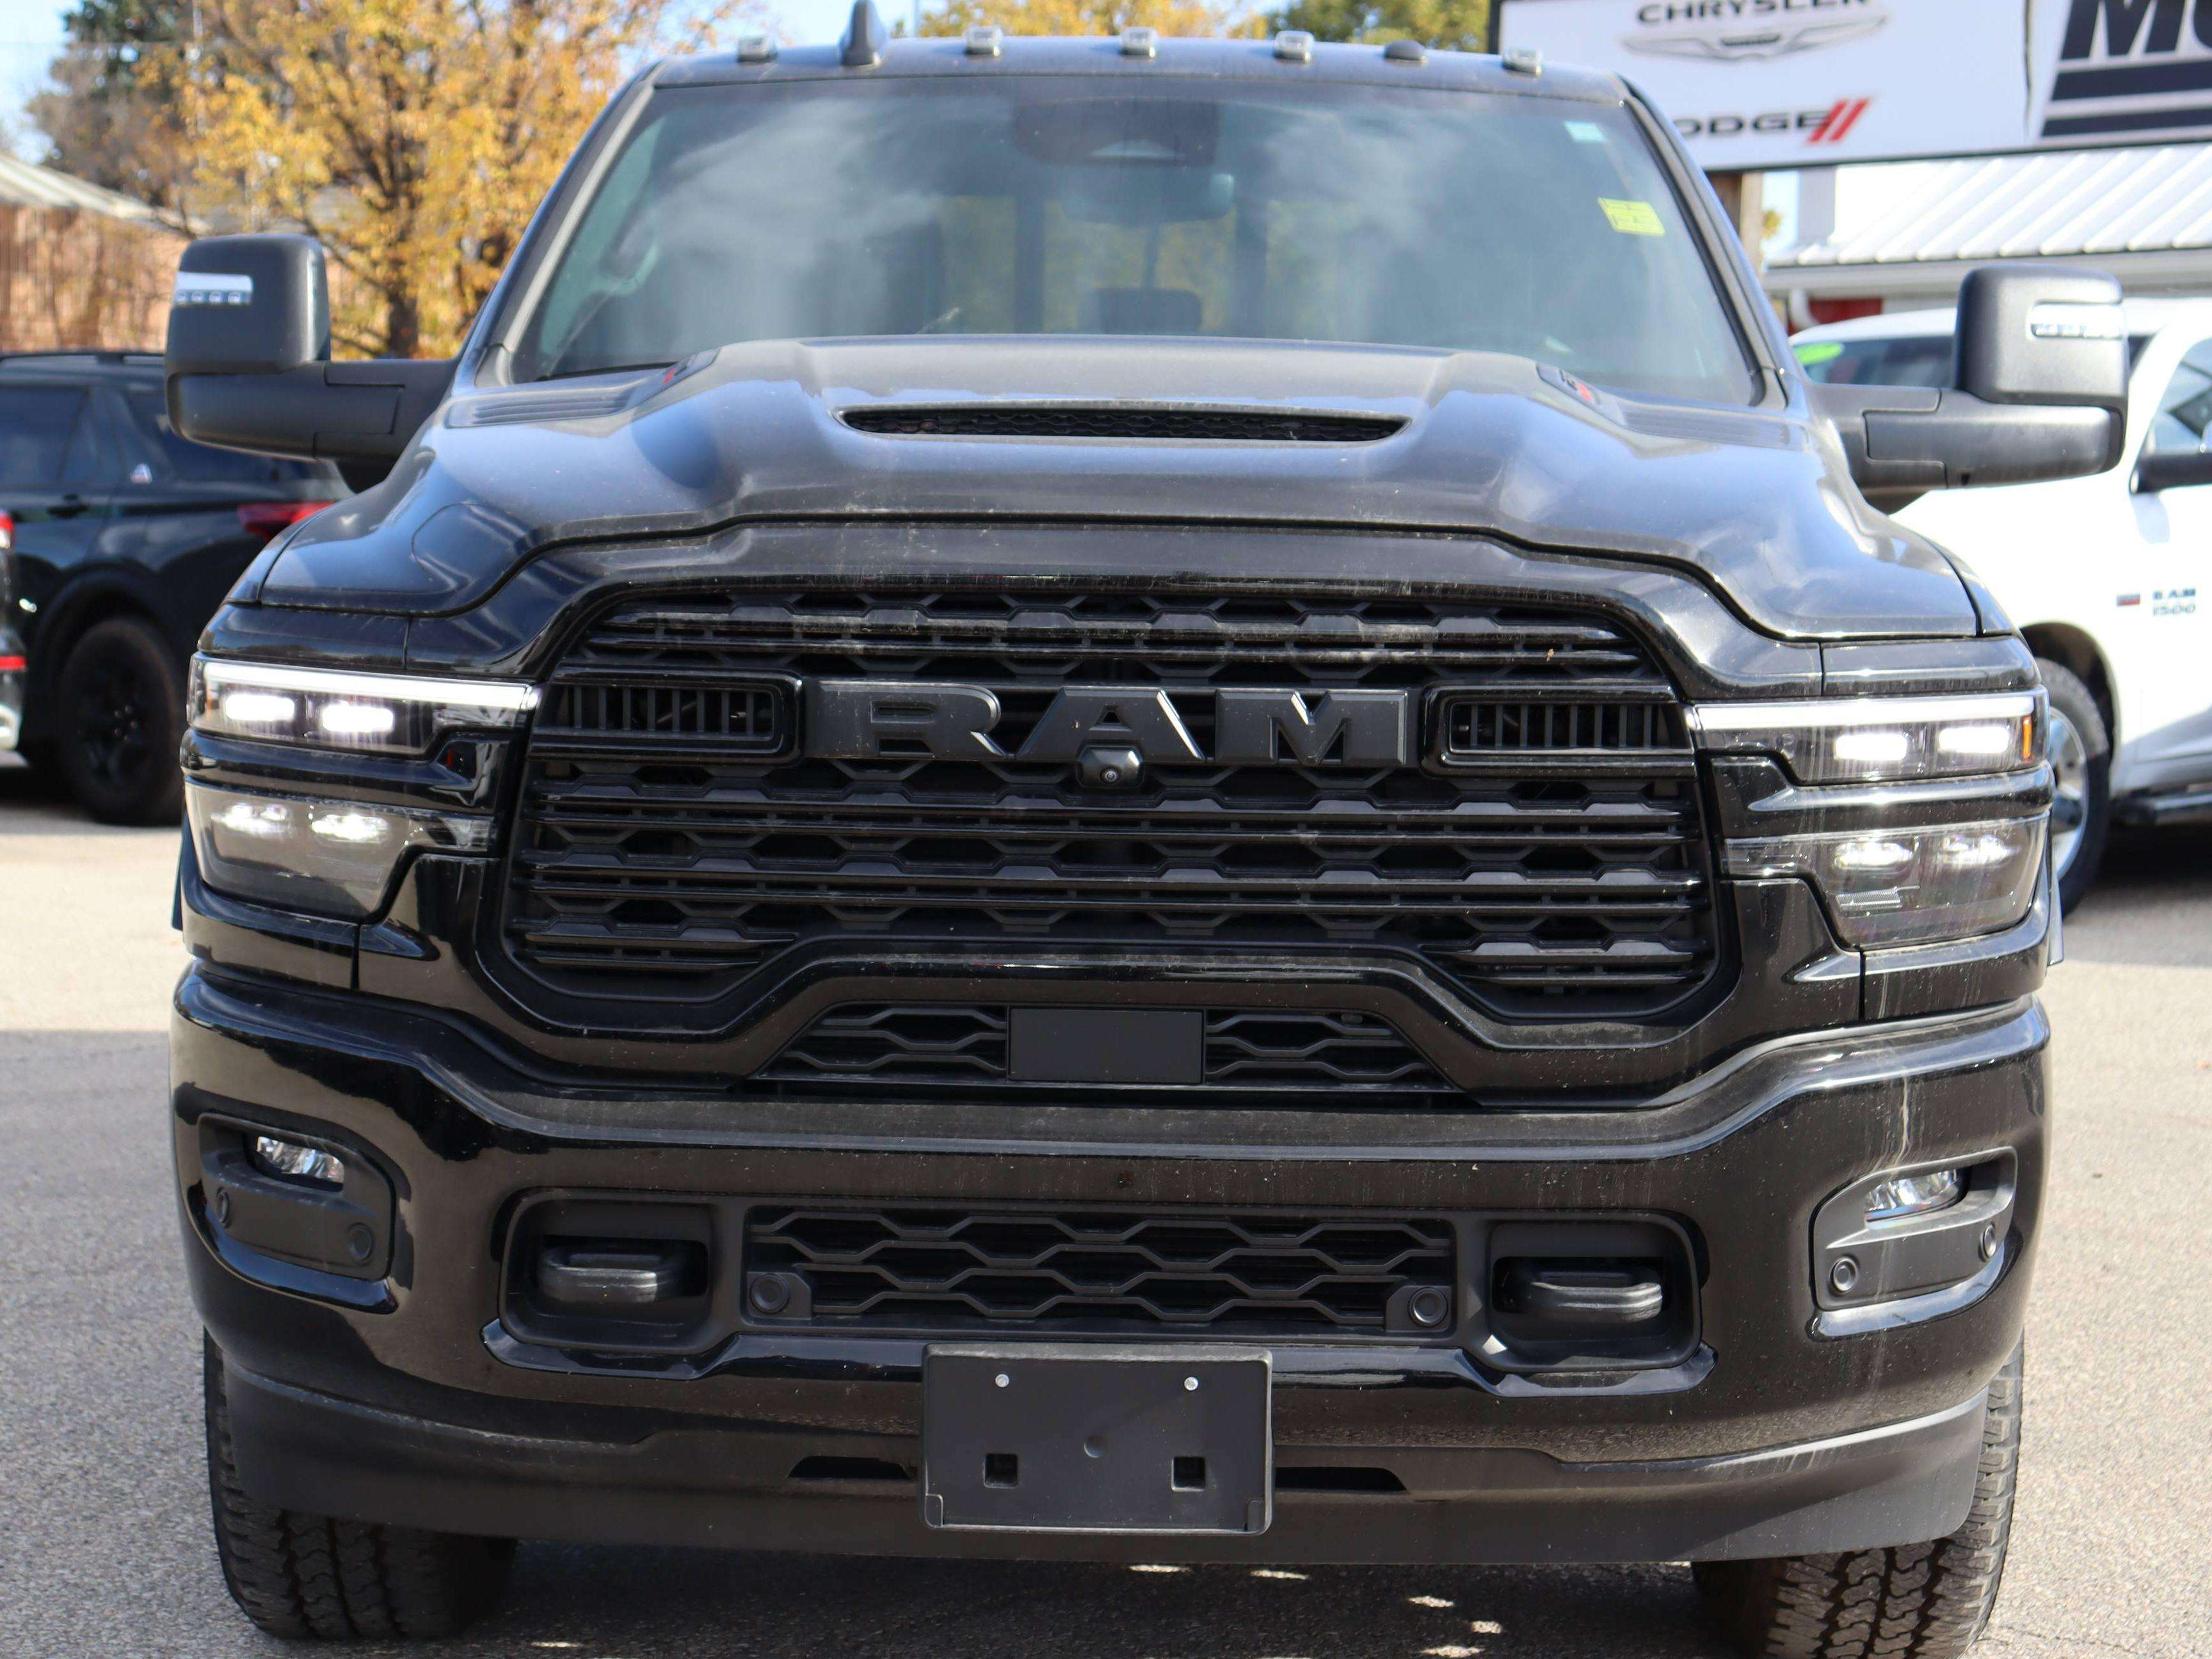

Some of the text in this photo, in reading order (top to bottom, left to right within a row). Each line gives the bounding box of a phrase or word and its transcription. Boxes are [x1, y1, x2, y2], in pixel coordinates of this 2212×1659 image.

[1638, 0, 1867, 23] CHRYSL
[1671, 109, 1834, 138] ODGE
[819, 680, 1409, 766] RAM
